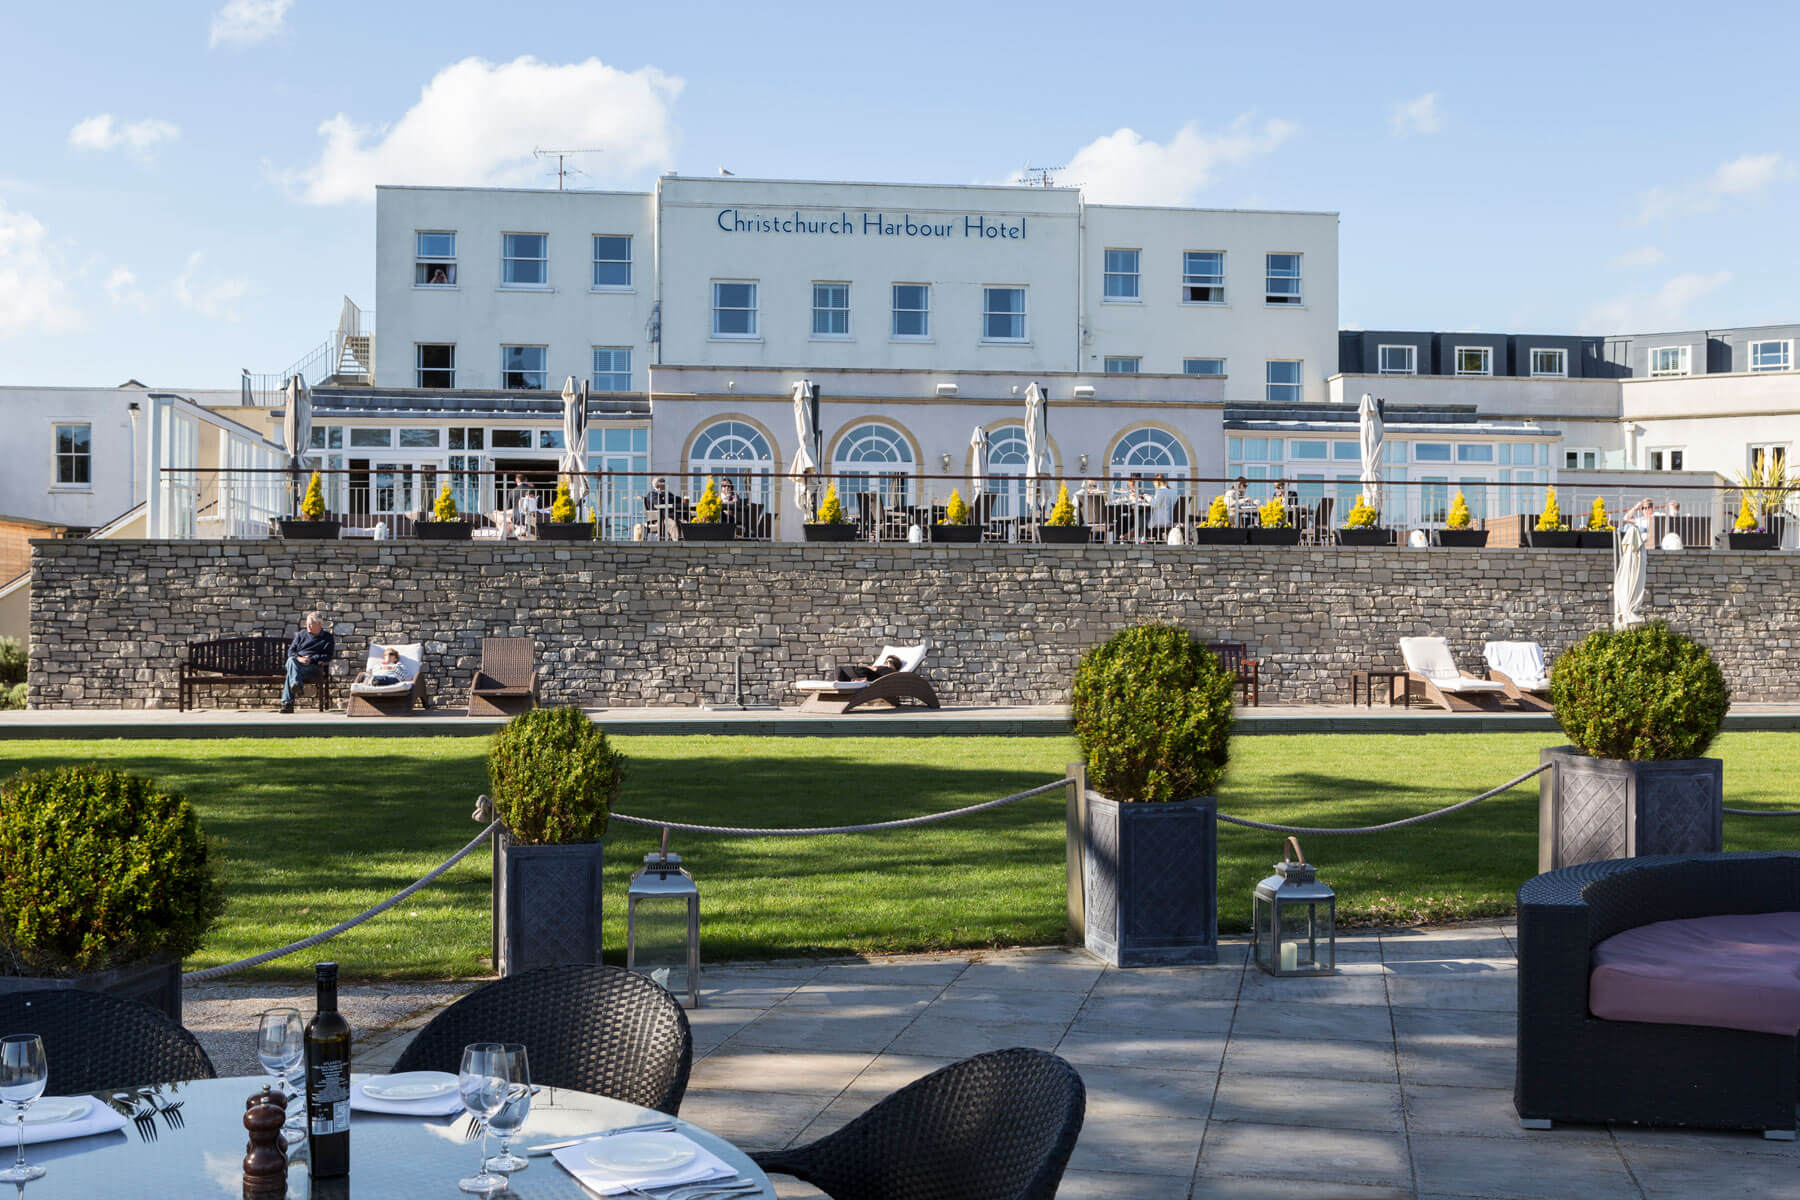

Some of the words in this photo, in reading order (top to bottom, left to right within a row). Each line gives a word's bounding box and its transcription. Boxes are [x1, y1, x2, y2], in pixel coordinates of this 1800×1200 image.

[718, 209, 853, 235] Christchurch
[863, 212, 953, 237] Harbour
[965, 215, 1026, 239] Hotel
